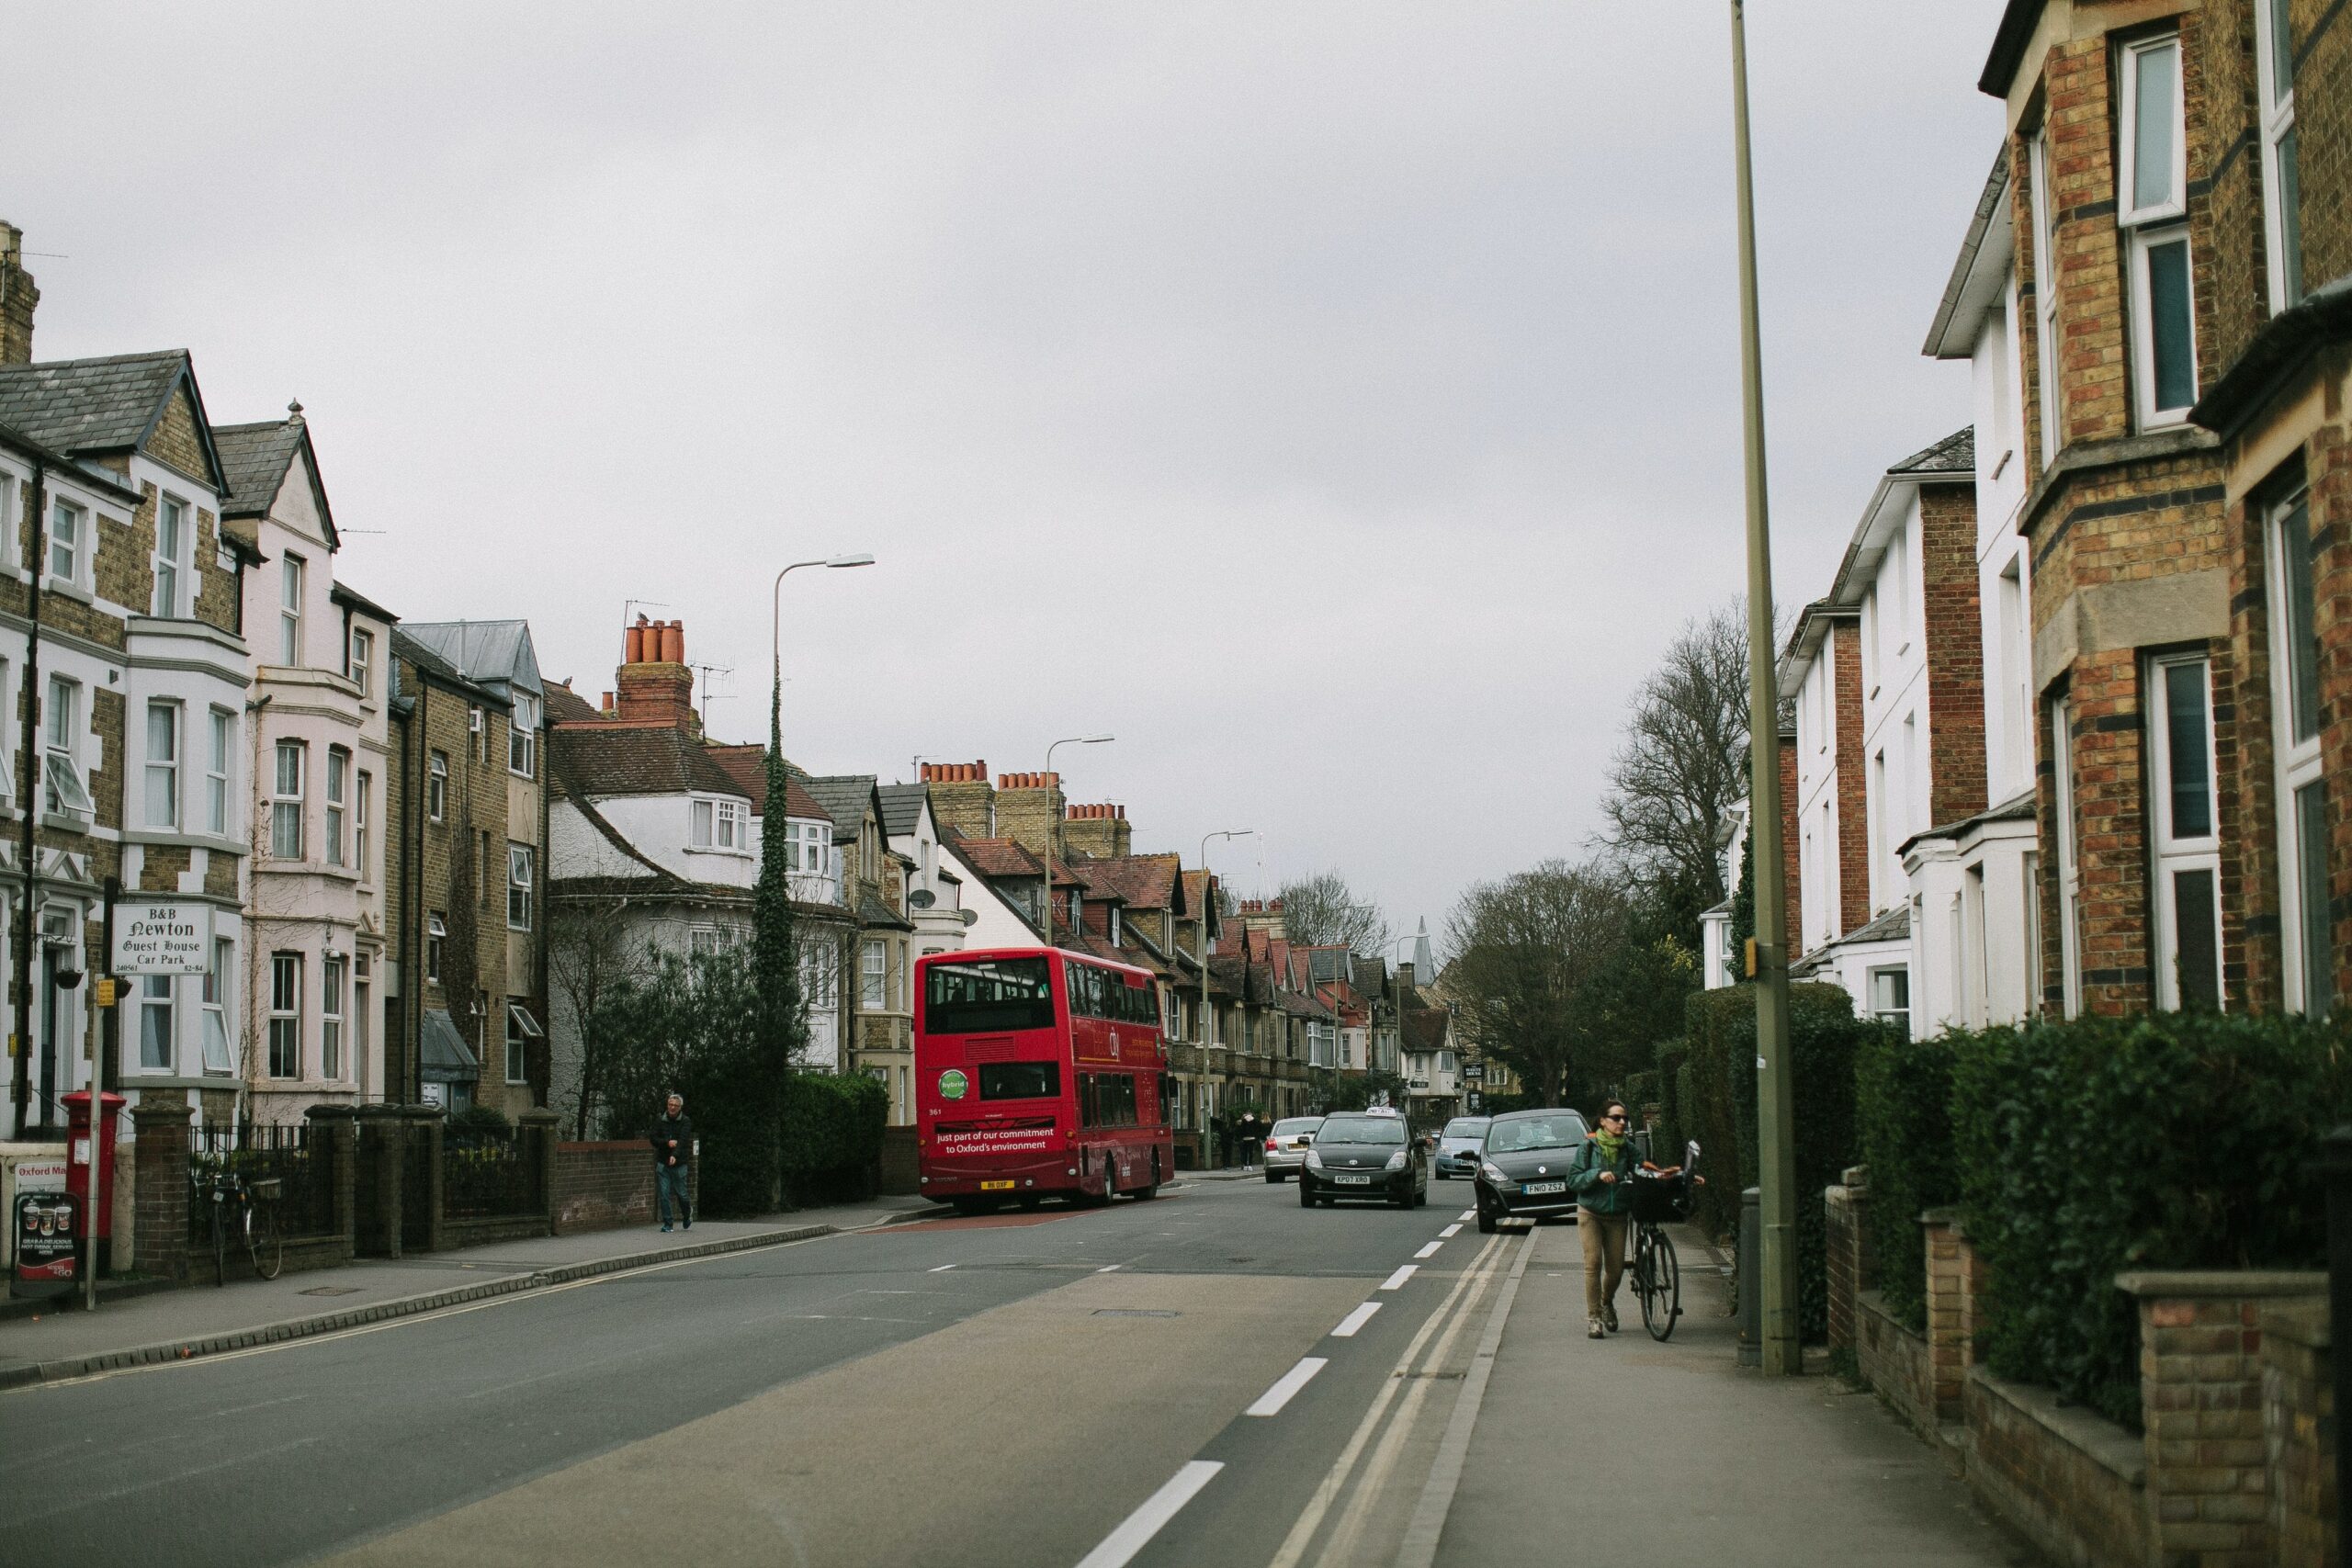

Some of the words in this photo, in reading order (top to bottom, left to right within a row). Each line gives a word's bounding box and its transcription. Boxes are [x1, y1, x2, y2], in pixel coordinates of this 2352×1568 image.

[149, 908, 176, 919] B&B
[128, 921, 194, 937] Newton
[122, 940, 157, 952] Guest
[164, 940, 200, 952] House
[137, 955, 156, 964] Car
[161, 954, 185, 964] Park
[942, 1080, 965, 1089] hybrid
[937, 1134, 953, 1144] just
[954, 1133, 971, 1143] part
[973, 1131, 981, 1140] of
[999, 1128, 1054, 1139] commitment
[945, 1145, 956, 1154] to
[956, 1143, 990, 1154] Oxford's
[991, 1141, 1046, 1151] environment
[18, 1167, 51, 1177] Oxford
[1548, 1183, 1563, 1191] ZSZ
